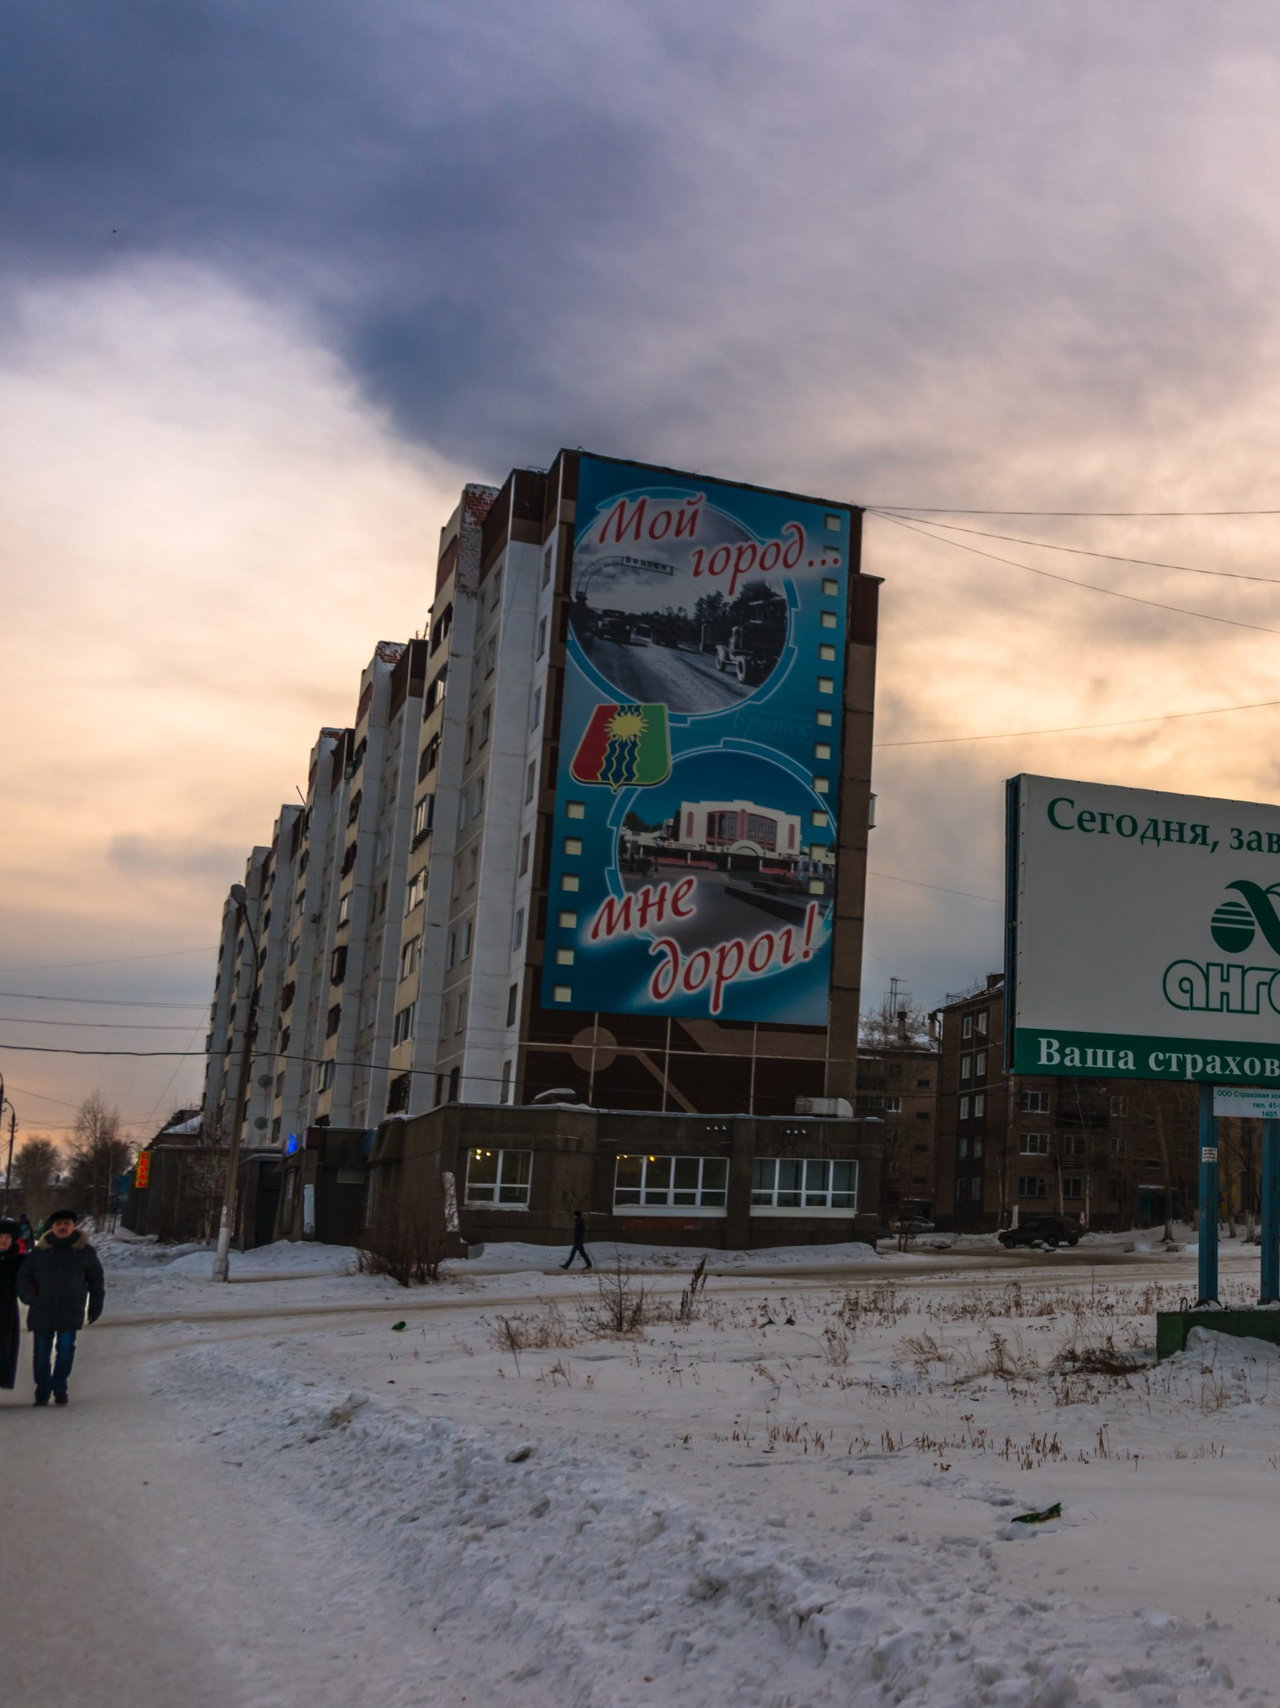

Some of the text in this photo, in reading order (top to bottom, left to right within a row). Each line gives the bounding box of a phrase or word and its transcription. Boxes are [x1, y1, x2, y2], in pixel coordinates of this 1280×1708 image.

[598, 493, 705, 545] Мой
[691, 524, 840, 596] город...
[1047, 797, 1220, 855] Сегодня,
[591, 878, 696, 940] мне
[649, 902, 817, 1014] дорог!
[1037, 1037, 1137, 1071] Ваша
[1217, 1089, 1232, 1097] ООО
[1234, 1091, 1270, 1100] Страховая
